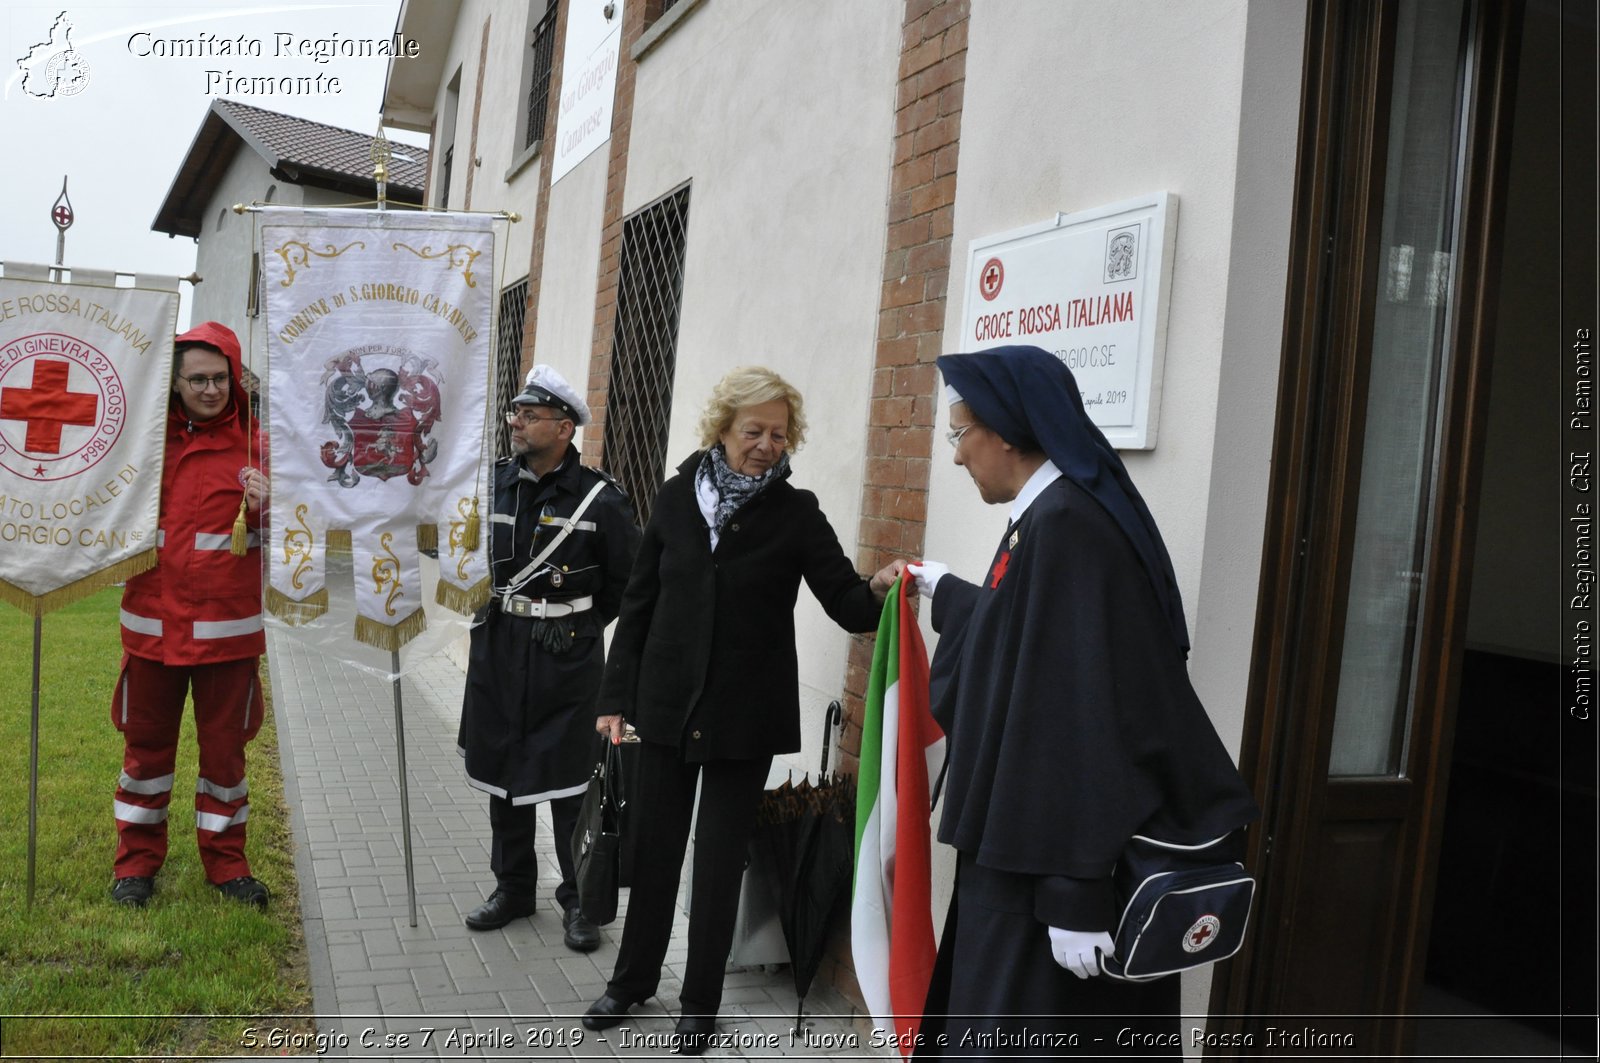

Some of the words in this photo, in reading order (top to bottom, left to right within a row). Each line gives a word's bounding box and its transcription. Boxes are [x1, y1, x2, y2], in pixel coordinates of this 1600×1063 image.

[560, 88, 576, 119] San
[577, 49, 616, 101] Giorgio
[560, 106, 604, 159] Canavese
[18, 294, 82, 316] ROSSA
[84, 302, 153, 355] ITALIANA
[279, 298, 331, 344] COMUNE
[333, 292, 347, 308] DI
[422, 293, 478, 345] CANAVESE
[975, 310, 1014, 342] CROCE
[1018, 303, 1062, 335] ROSSA
[1066, 291, 1134, 329] ITALIANA
[7, 345, 22, 361] DI
[24, 338, 90, 362] GINEVRA
[90, 356, 109, 376] 22
[102, 375, 122, 437] AGOSTO
[1085, 393, 1104, 409] aprile
[1106, 390, 1127, 404] 2019
[81, 437, 109, 463] 1864
[40, 480, 122, 520] LOCALE
[118, 463, 139, 486] DI
